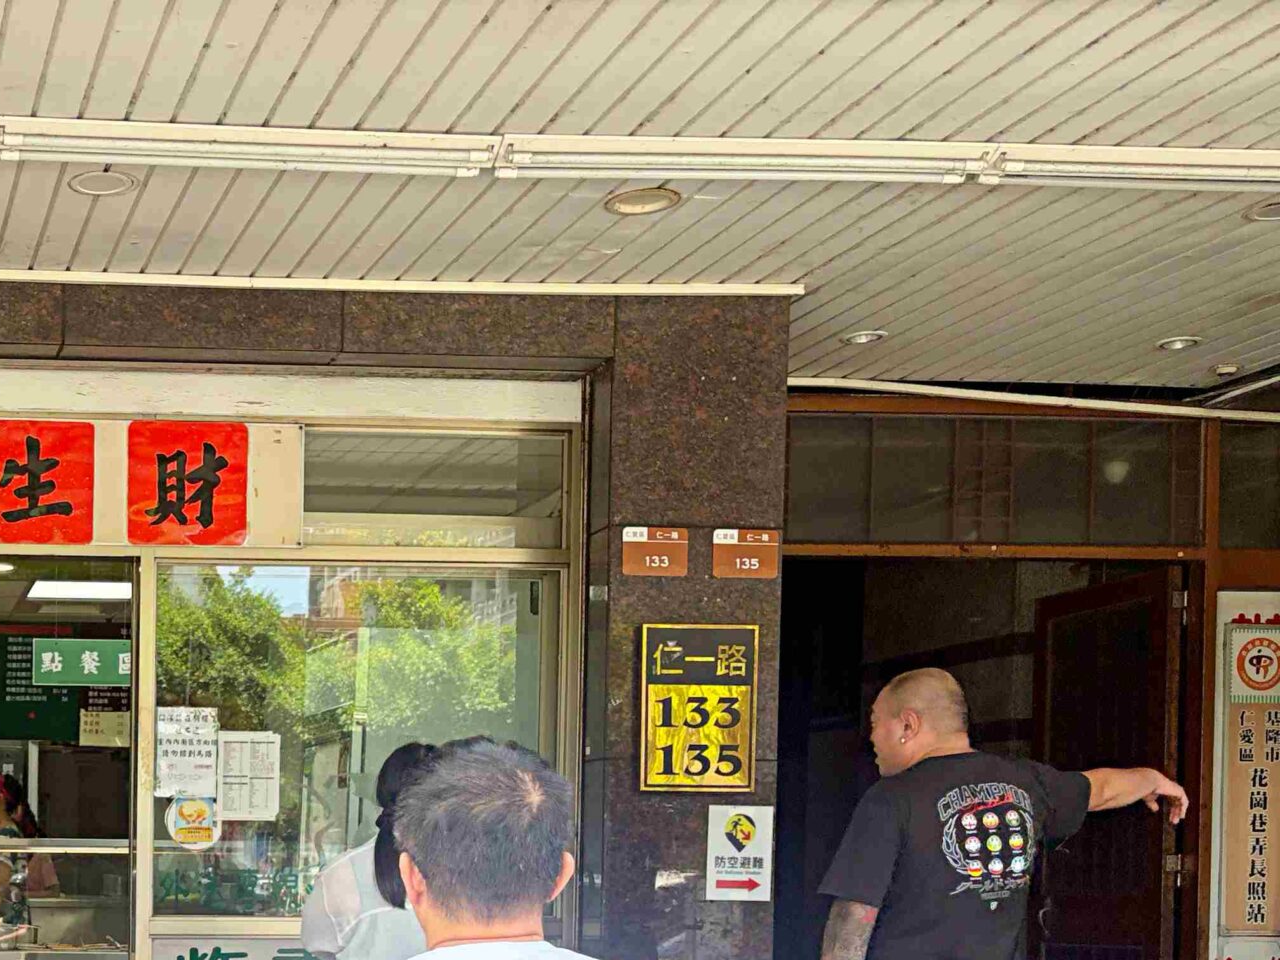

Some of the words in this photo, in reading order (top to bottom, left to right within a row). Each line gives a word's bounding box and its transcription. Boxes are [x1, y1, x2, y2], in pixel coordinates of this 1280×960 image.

[656, 530, 679, 540] 仁一路
[746, 532, 770, 542] 仁一路
[644, 555, 670, 568] 133
[735, 557, 760, 570] 135
[652, 643, 747, 678] 仁一路
[655, 696, 742, 730] 133
[1239, 709, 1256, 763] 仁愛區
[655, 743, 742, 777] 135
[714, 855, 764, 870] 防空避難
